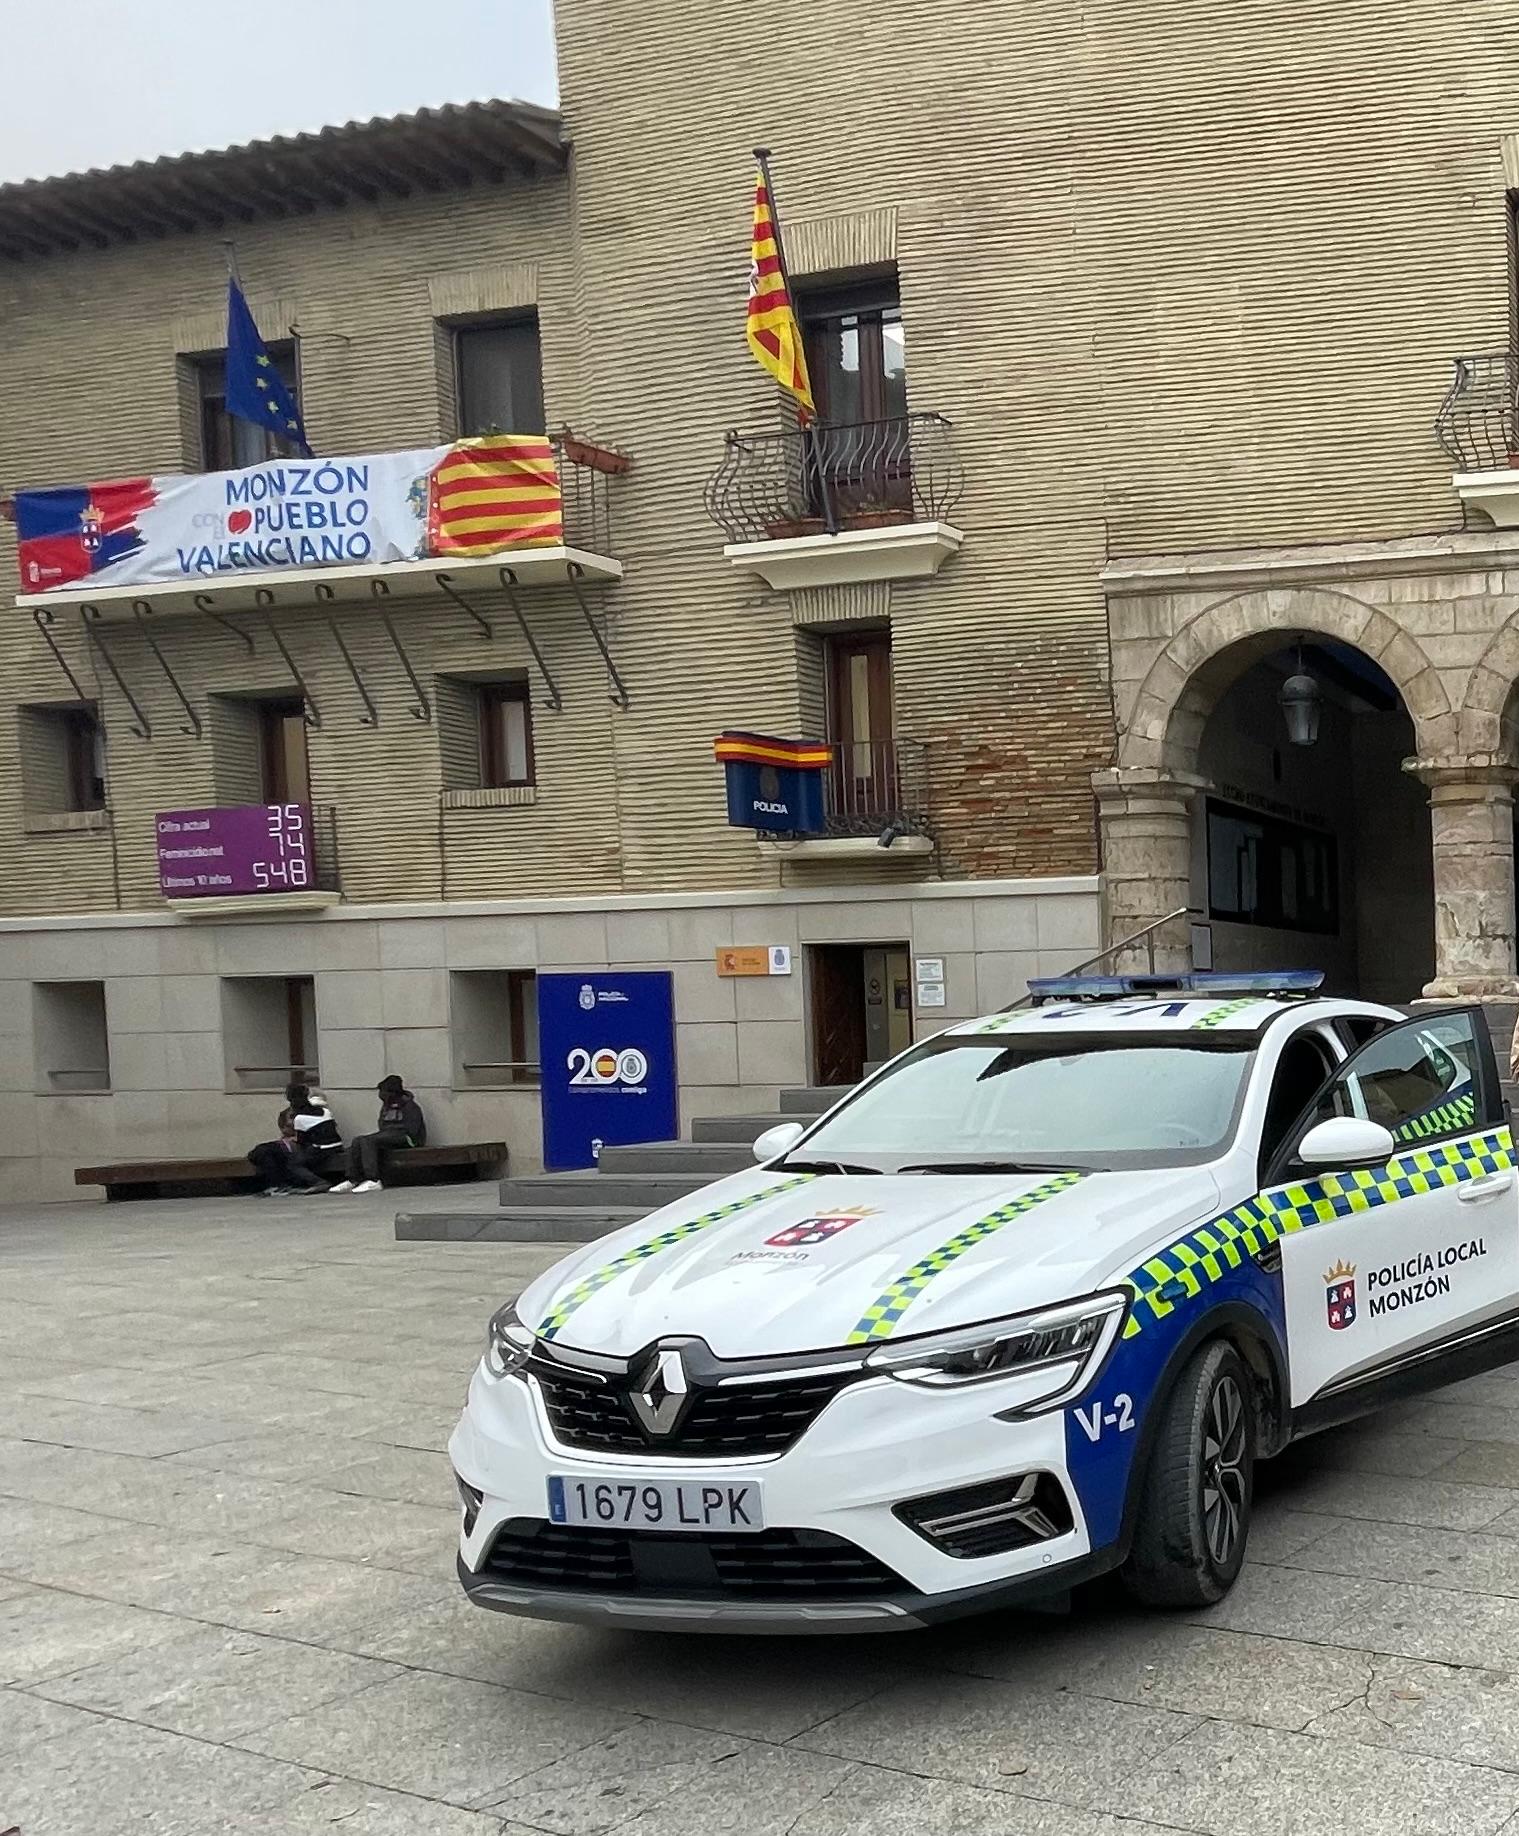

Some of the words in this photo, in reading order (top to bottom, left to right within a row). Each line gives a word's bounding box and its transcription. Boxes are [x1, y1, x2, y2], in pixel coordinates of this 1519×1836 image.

[227, 461, 368, 505] MONZÓN
[255, 499, 369, 533] PUEBLO
[177, 532, 371, 574] VALENCIANO
[268, 804, 302, 831] 35
[269, 833, 304, 856] 74
[253, 859, 307, 888] 548
[567, 1048, 647, 1084] 200
[1368, 1253, 1434, 1291] POLICÍA
[1438, 1238, 1487, 1268] LOCAL
[1368, 1275, 1451, 1317] MONZÓN
[1073, 1393, 1135, 1442] V-2
[576, 1483, 663, 1522] 1679
[676, 1487, 751, 1525] LPK
